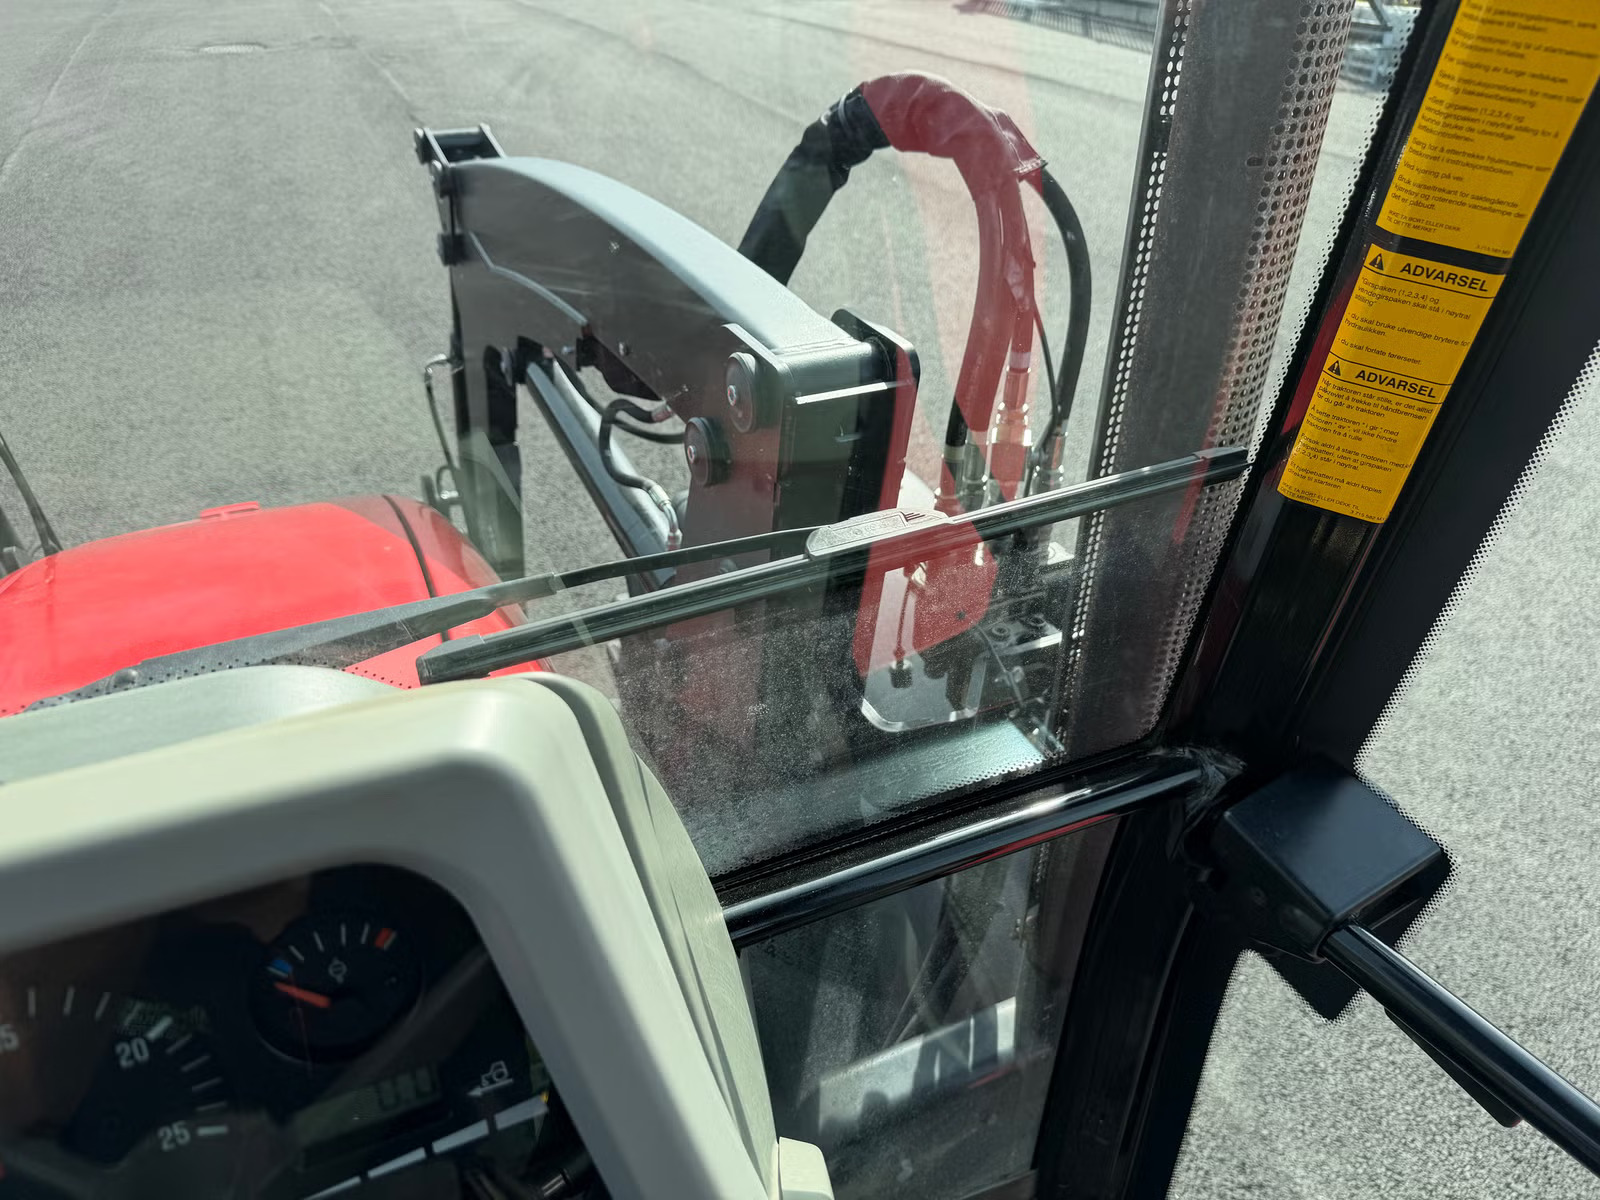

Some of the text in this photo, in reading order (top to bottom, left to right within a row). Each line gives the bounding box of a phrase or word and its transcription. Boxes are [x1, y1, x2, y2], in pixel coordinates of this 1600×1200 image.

[1400, 263, 1486, 291] ADVARSEL
[1356, 286, 1411, 305] vendegirspaken
[1375, 320, 1396, 330] bruke
[1397, 327, 1432, 339] utvendige
[1433, 334, 1459, 345] brytere
[1364, 346, 1386, 356] forlate
[1332, 383, 1361, 396] traktoren
[1355, 370, 1434, 398] ADVARSEL
[1351, 396, 1371, 406] trekke
[1380, 404, 1426, 420] håndbremsen
[1331, 414, 1360, 426] traktoren
[1375, 434, 1397, 443] hindre
[1341, 448, 1359, 456] starte
[1360, 453, 1388, 464] motoren
[1359, 460, 1392, 472] girspaken
[115, 1037, 150, 1069] 20
[157, 1121, 191, 1151] 25
